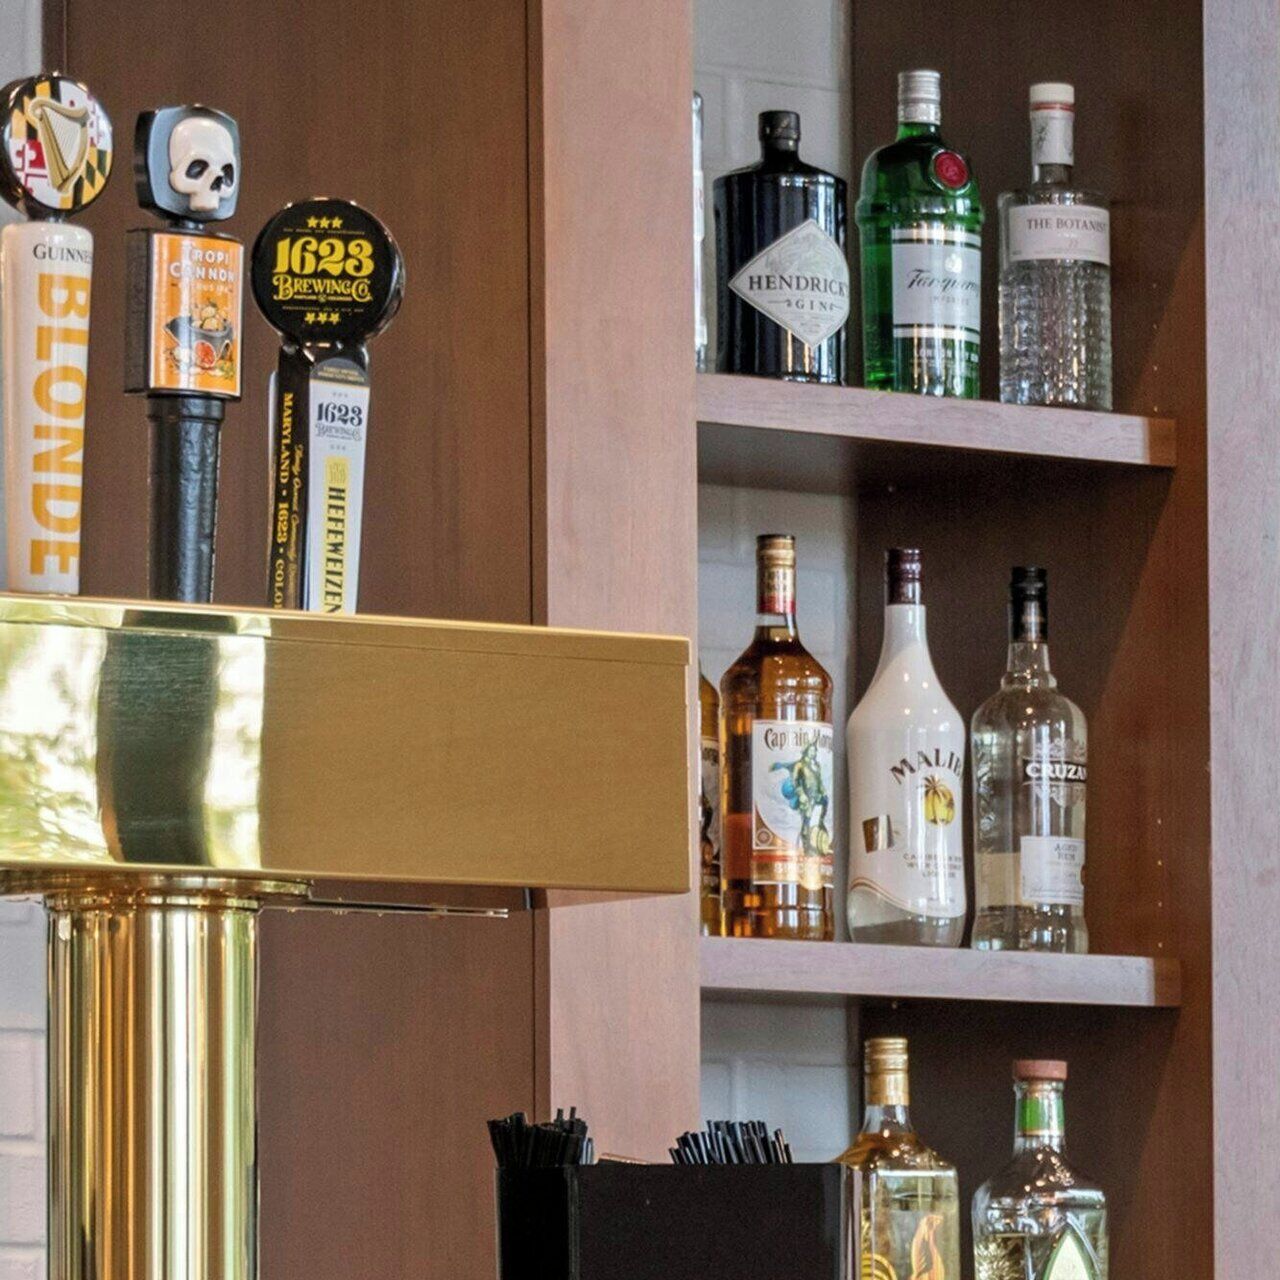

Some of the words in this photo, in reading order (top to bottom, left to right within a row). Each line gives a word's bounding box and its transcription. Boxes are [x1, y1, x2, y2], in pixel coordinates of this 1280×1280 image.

[1026, 218, 1052, 230] THE
[273, 236, 375, 276] 1623
[272, 274, 352, 301] BREWING
[795, 300, 828, 311] GIN
[30, 273, 91, 576] BLONDE
[317, 402, 363, 427] 1623
[281, 392, 294, 484] MARYLAND
[276, 502, 289, 544] 1623
[764, 728, 810, 751] Capain
